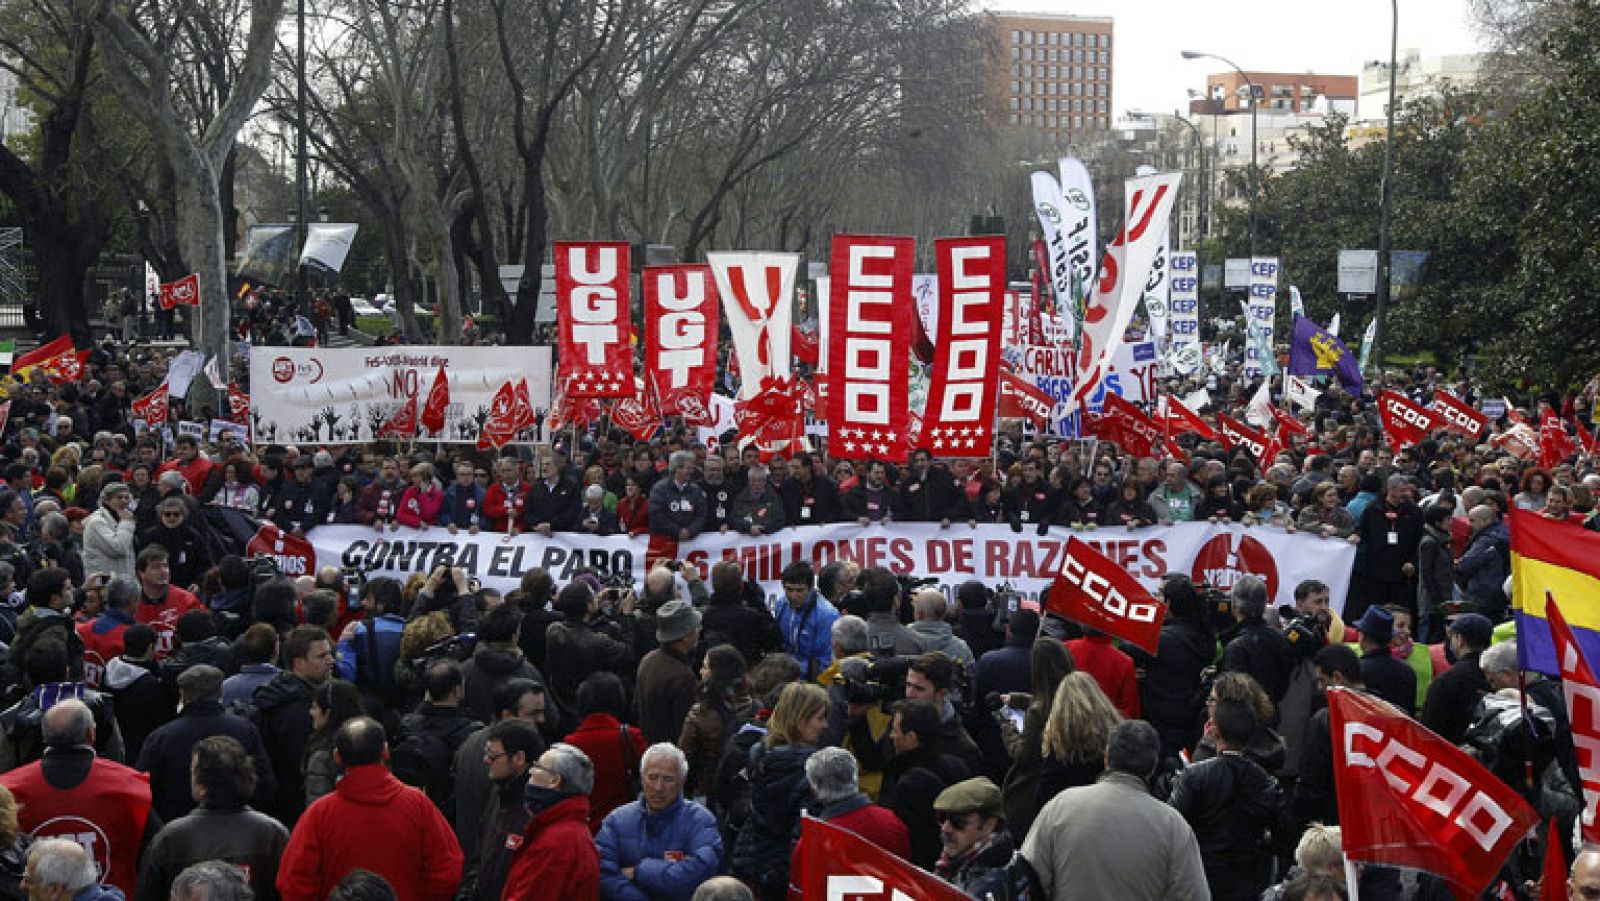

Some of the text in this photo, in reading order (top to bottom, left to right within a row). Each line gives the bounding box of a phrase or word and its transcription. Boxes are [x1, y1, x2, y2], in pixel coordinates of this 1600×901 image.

[1171, 256, 1196, 270] CEP
[1251, 262, 1276, 277] CEP
[1172, 277, 1196, 291] CEP
[1251, 284, 1275, 298] CEP
[568, 247, 618, 365] UGT
[1172, 300, 1197, 313] CEP
[657, 271, 705, 388] UGT
[844, 245, 896, 424] CCOO
[939, 245, 990, 421] CCOO
[1173, 320, 1197, 334] CEP
[393, 368, 418, 398] NO
[1387, 399, 1431, 430] CCOO
[1436, 400, 1480, 433] CCOO
[341, 539, 478, 577] CONTRA
[487, 544, 527, 577] EL
[541, 546, 632, 582] PARO
[926, 538, 975, 575] DE
[984, 539, 1168, 579] RAZNES
[1060, 554, 1159, 623] CCOO
[1343, 721, 1514, 852] CCOO
